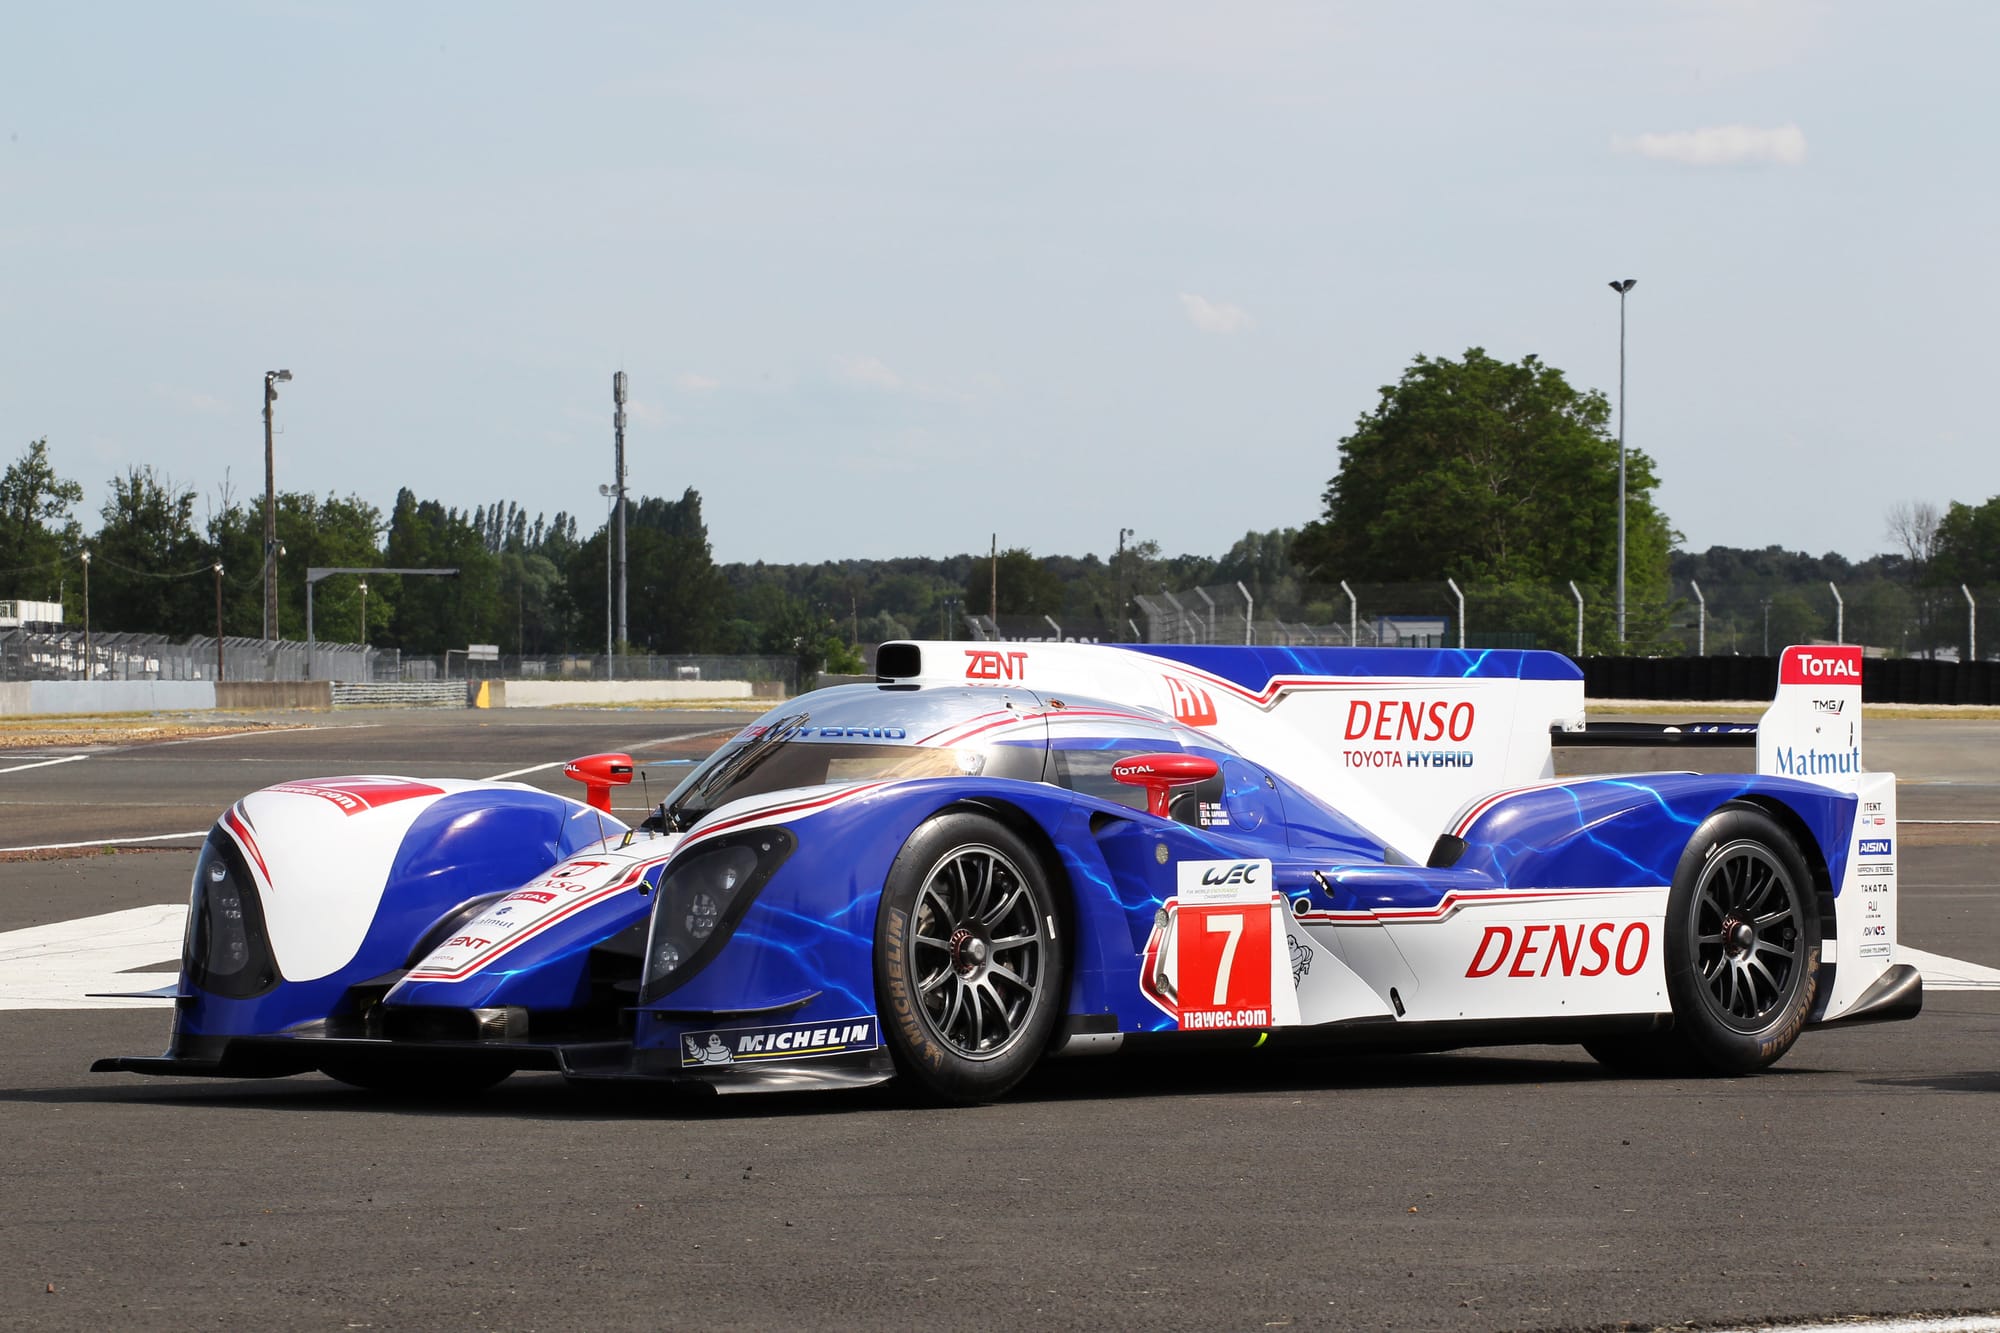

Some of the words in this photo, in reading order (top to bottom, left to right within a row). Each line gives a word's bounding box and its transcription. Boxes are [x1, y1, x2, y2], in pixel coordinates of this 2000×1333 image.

[964, 650, 1029, 680] ZENT
[1797, 654, 1860, 677] TOTAL
[1812, 700, 1837, 710] TMG
[1344, 700, 1475, 741] DENSO
[1114, 765, 1155, 776] TOTAL
[1343, 750, 1403, 767] TOYOTA
[1407, 750, 1474, 767] HYBRID
[1776, 746, 1860, 776] Matmut
[1860, 842, 1889, 853] AISIN
[1201, 863, 1260, 886] WEC
[1861, 884, 1888, 892] TAKATA
[1206, 914, 1244, 1006] 7
[1465, 922, 1650, 978] DENSO
[887, 911, 925, 1045] MICHELIN
[737, 1024, 869, 1052] MICHELIN
